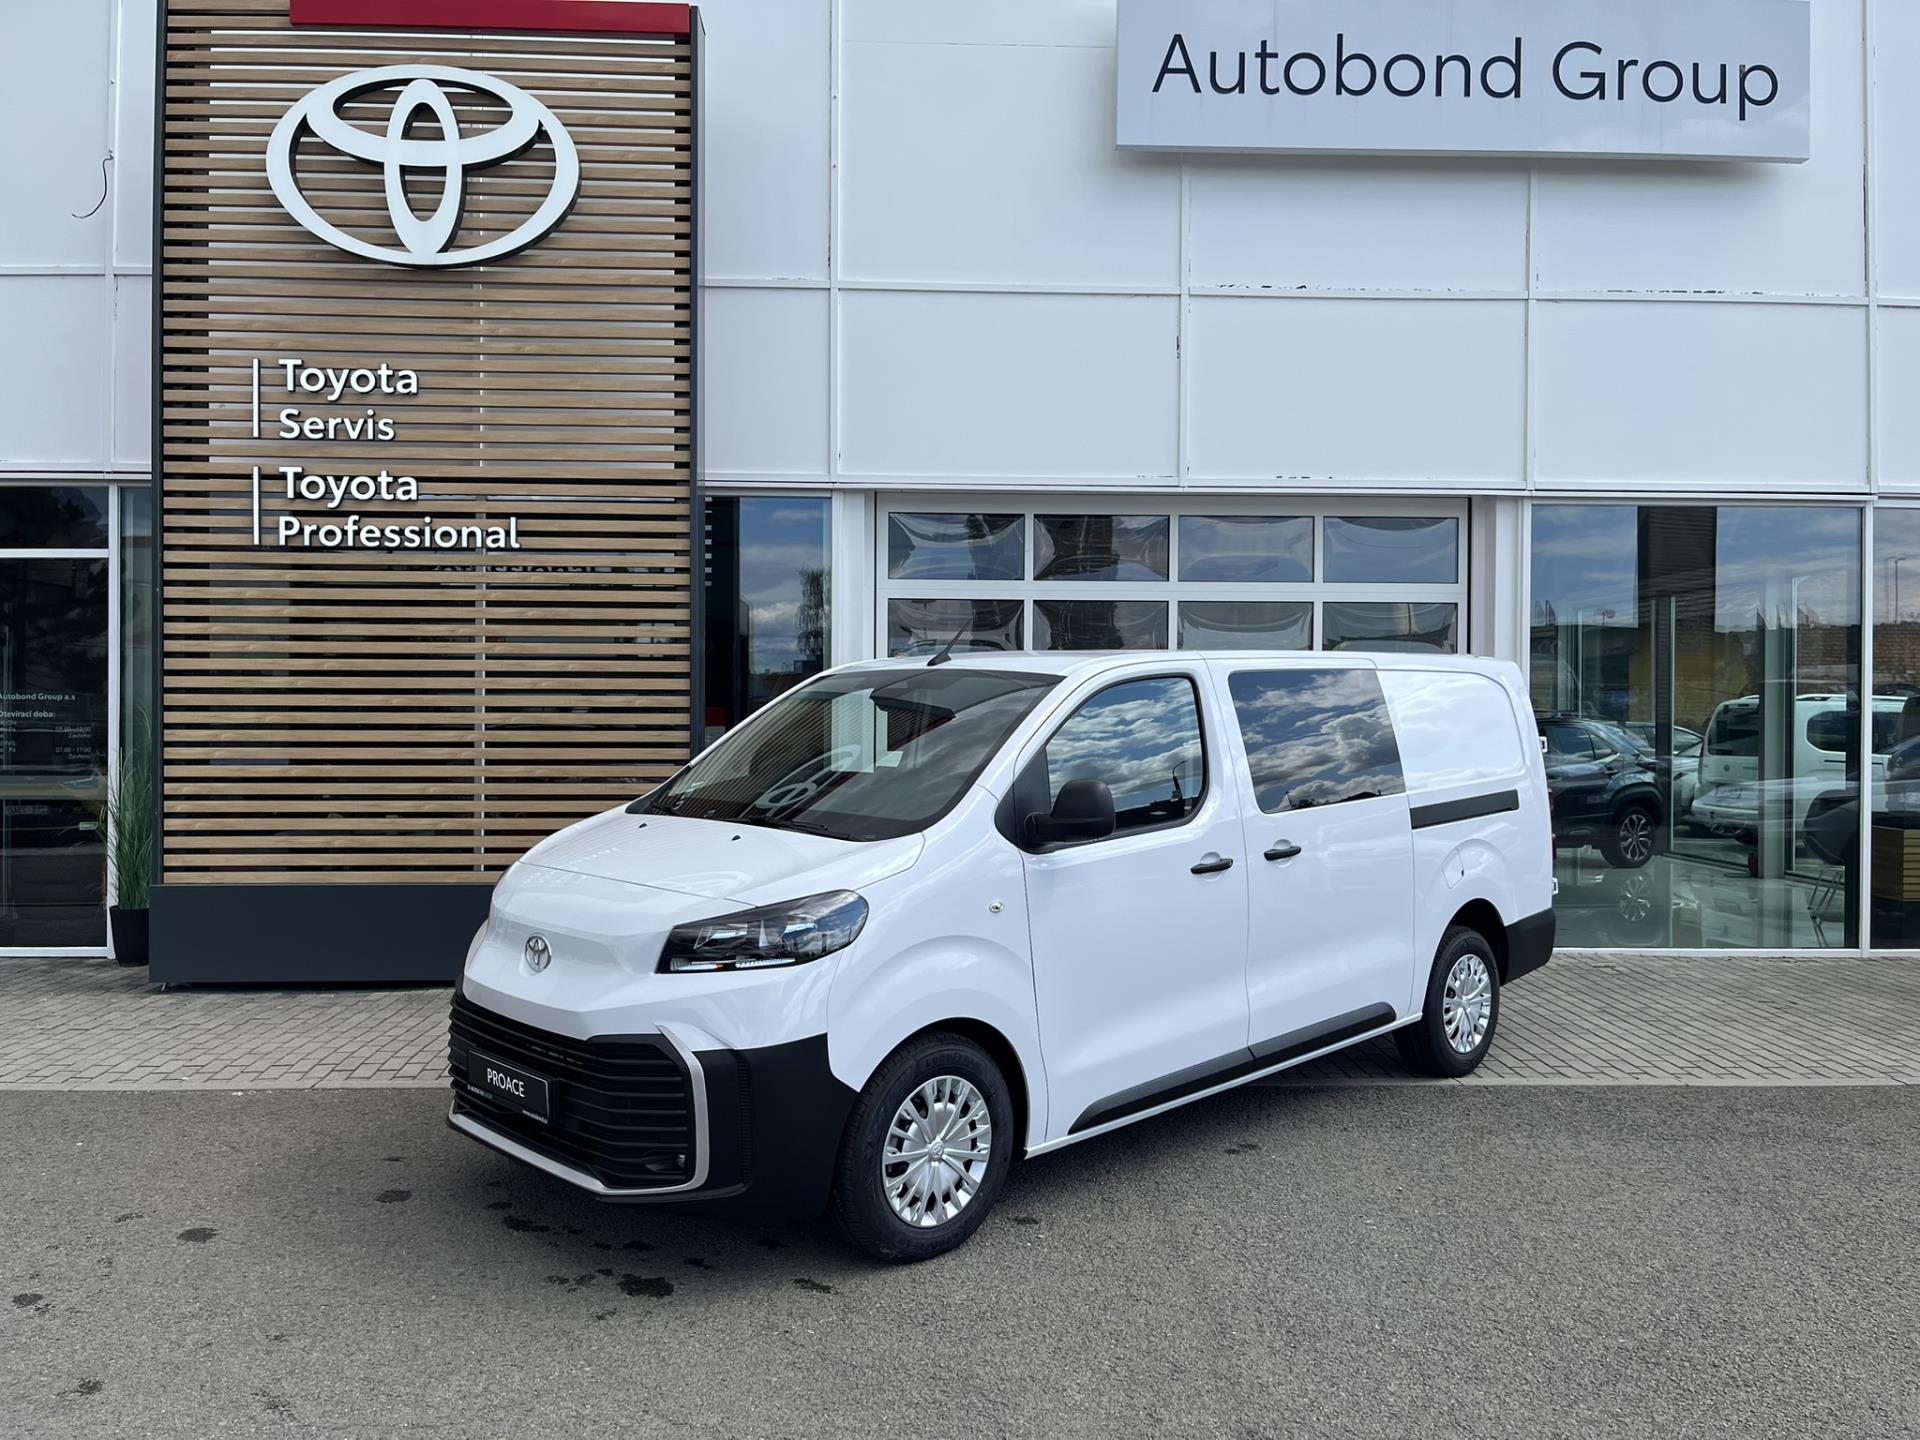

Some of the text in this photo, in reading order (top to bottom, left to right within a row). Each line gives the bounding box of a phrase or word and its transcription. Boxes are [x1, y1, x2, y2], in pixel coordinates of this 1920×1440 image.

[1151, 33, 1779, 122] Autobond Group
[278, 358, 419, 402] Toyota
[279, 408, 395, 441] Servis
[278, 466, 419, 509] Toyota
[279, 515, 521, 549] Professional
[37, 693, 63, 703] Group
[486, 1067, 526, 1098] PROACE
